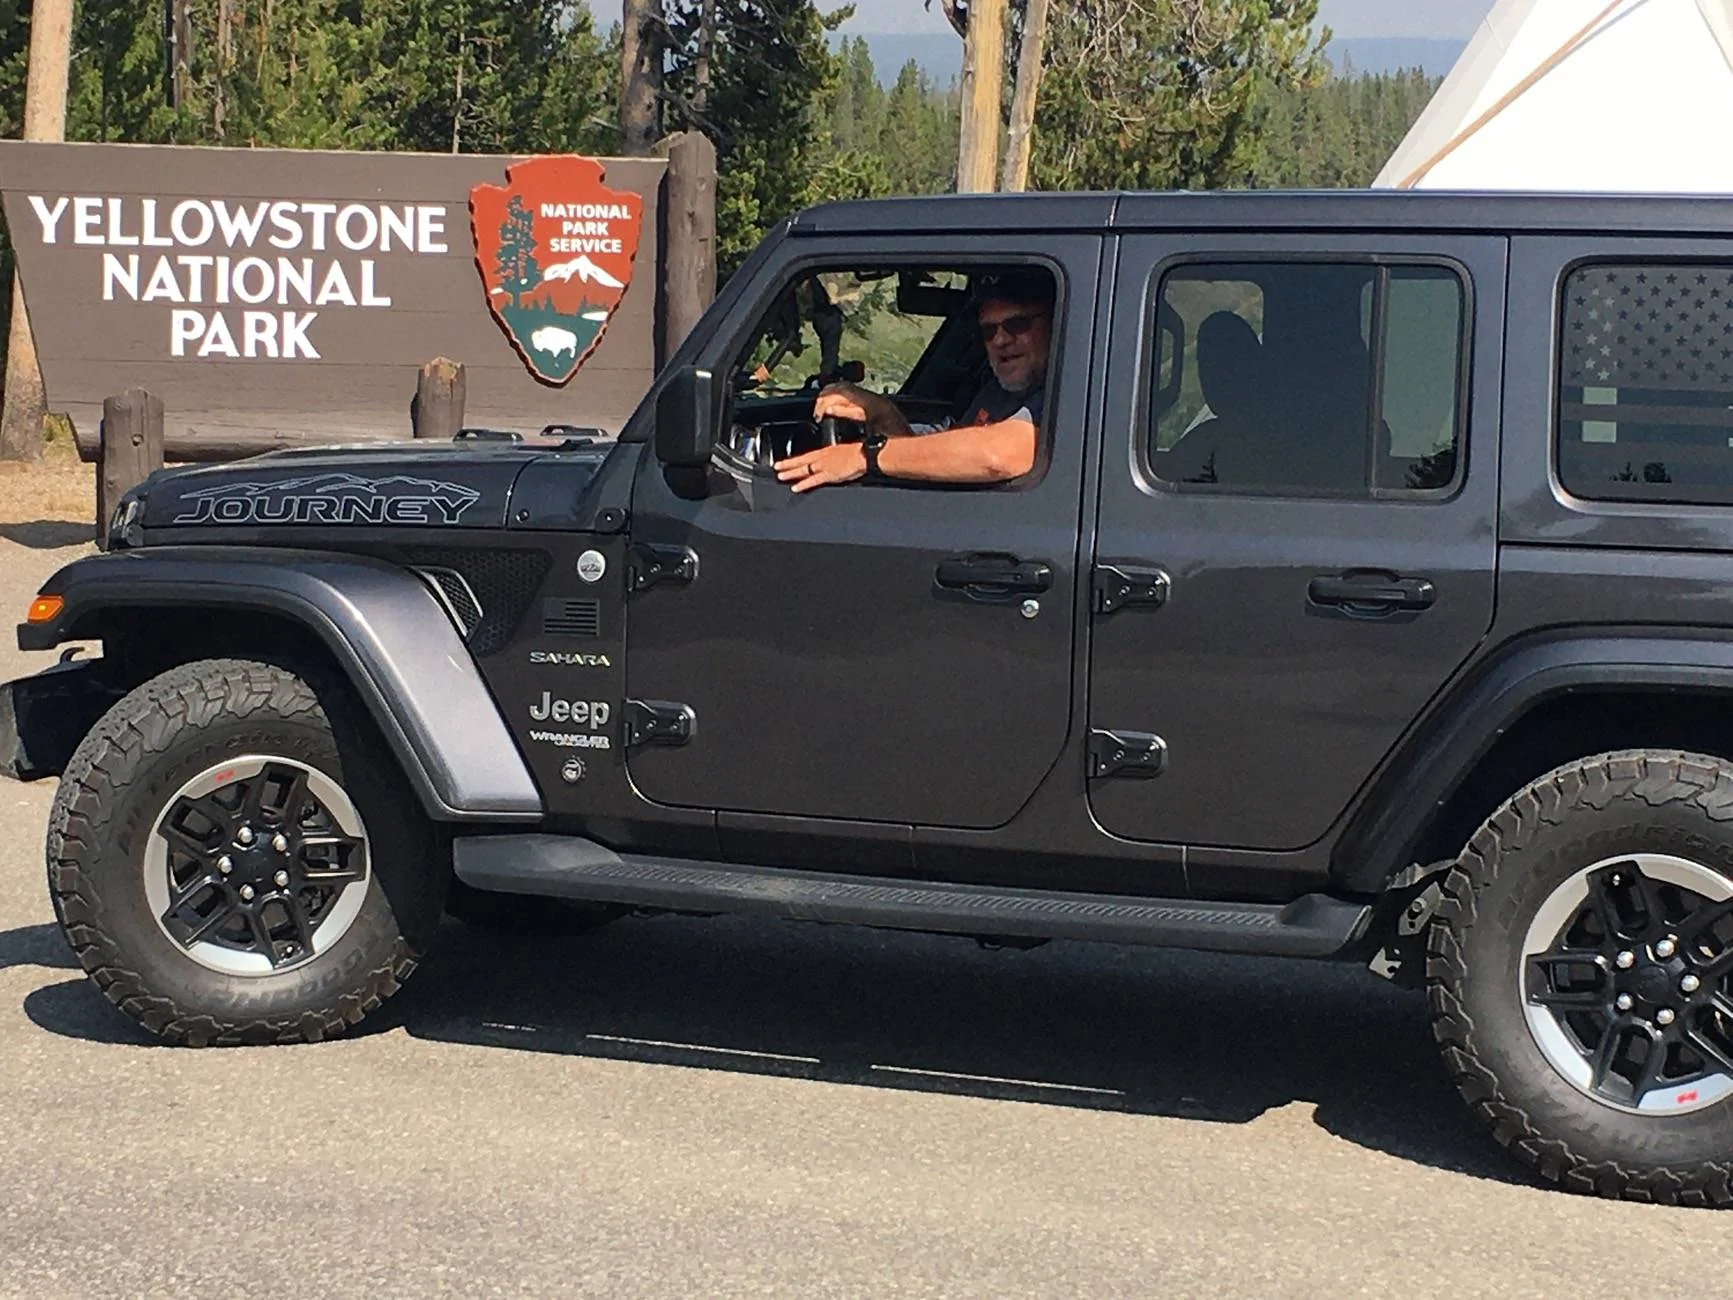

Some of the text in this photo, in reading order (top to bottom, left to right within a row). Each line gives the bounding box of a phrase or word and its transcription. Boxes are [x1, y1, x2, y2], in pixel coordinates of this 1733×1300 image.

[27, 195, 448, 254] YELLOWSTONE
[539, 203, 632, 220] NATIONAL
[561, 220, 609, 237] PARK
[548, 237, 622, 254] SERVICE
[102, 253, 392, 307] NATIONAL
[170, 310, 321, 360] PARK
[173, 494, 479, 524] JOURNEY
[530, 651, 610, 666] SAHARA
[529, 691, 610, 730] Jeep
